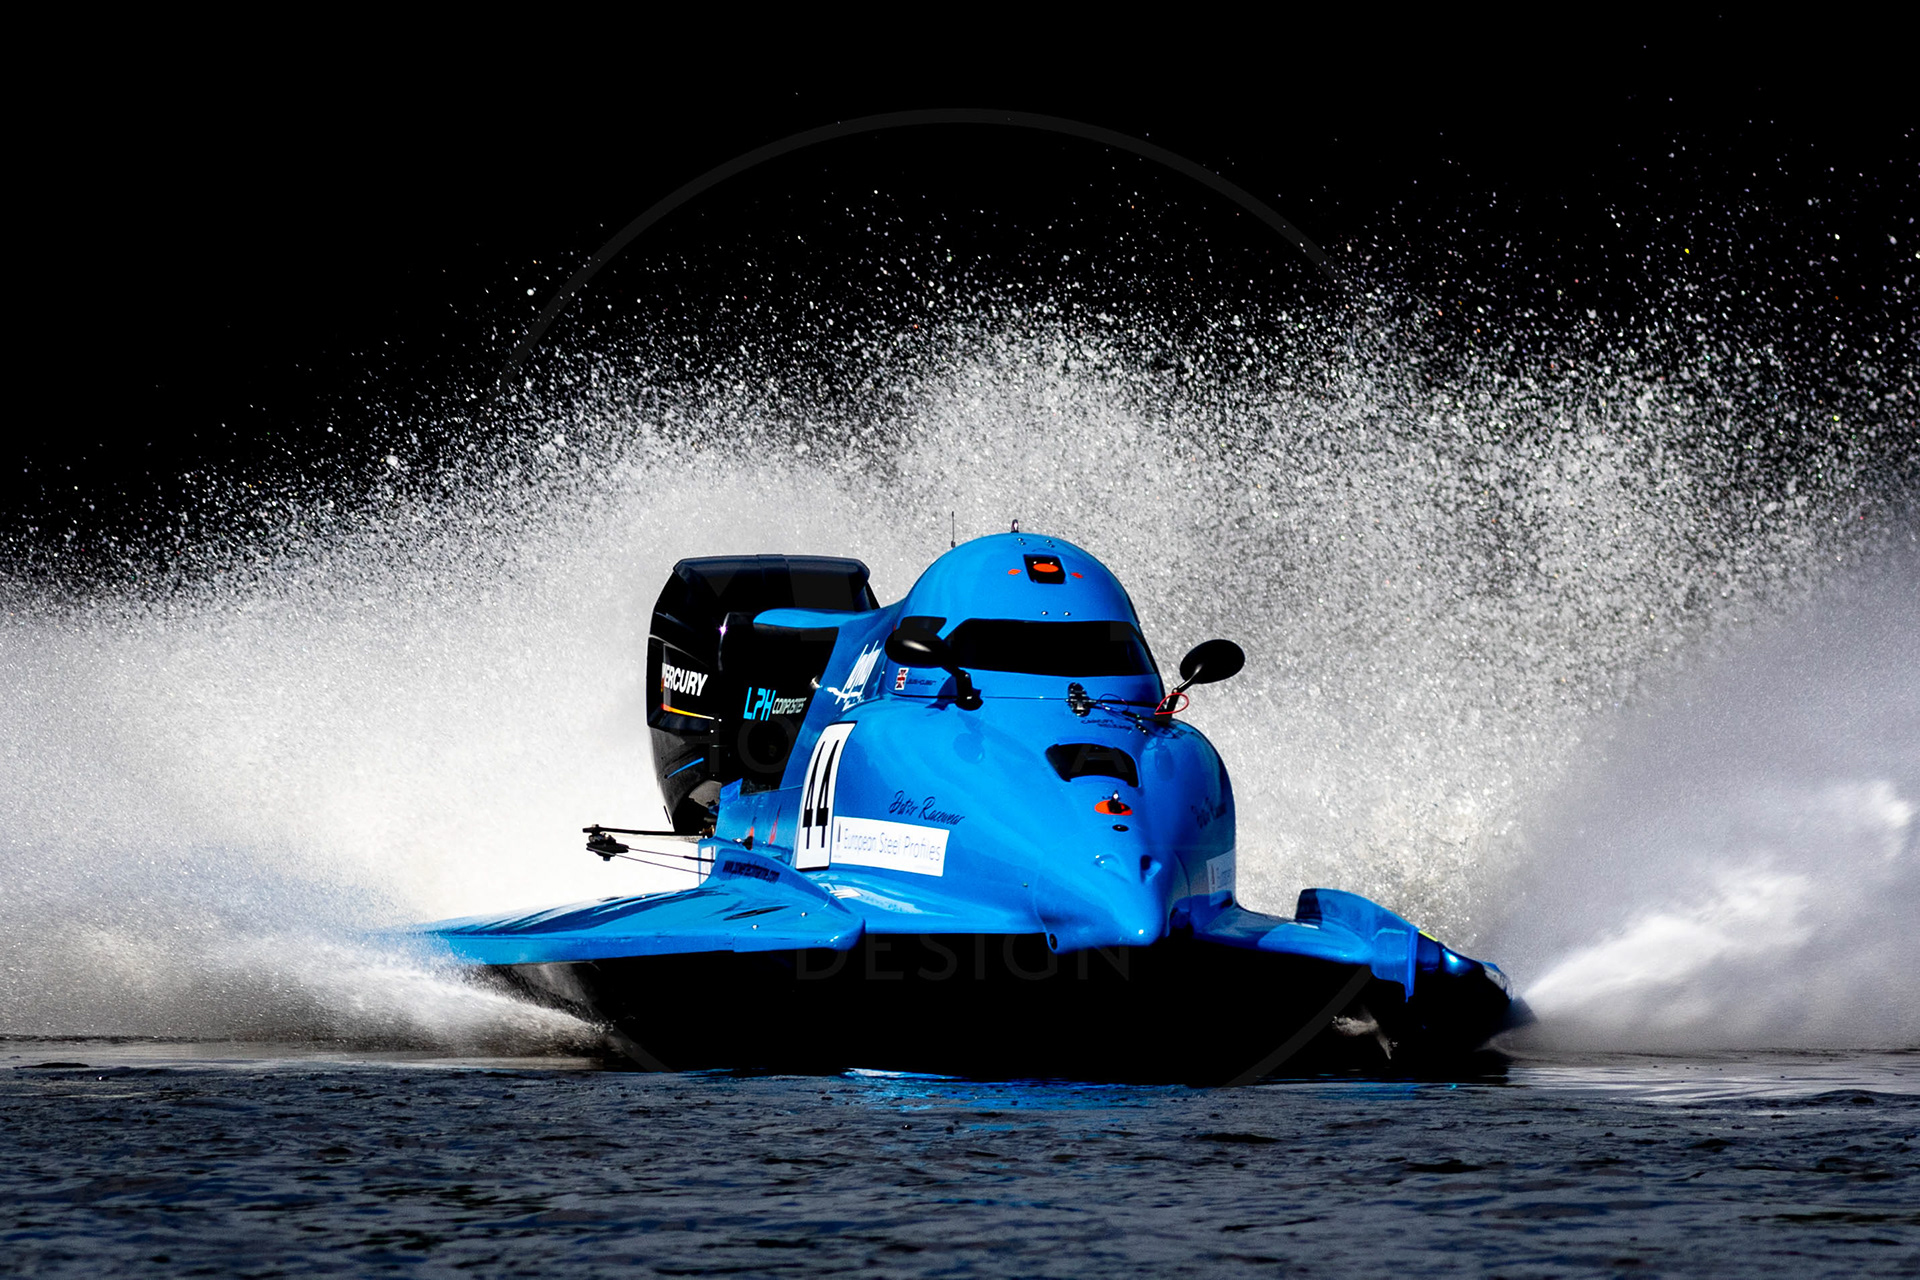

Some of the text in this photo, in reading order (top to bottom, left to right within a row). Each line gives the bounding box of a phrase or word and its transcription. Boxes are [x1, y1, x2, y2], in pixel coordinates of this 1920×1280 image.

[743, 687, 776, 721] LPH
[803, 740, 839, 849] 44
[843, 828, 941, 862] European Steel Profiles
